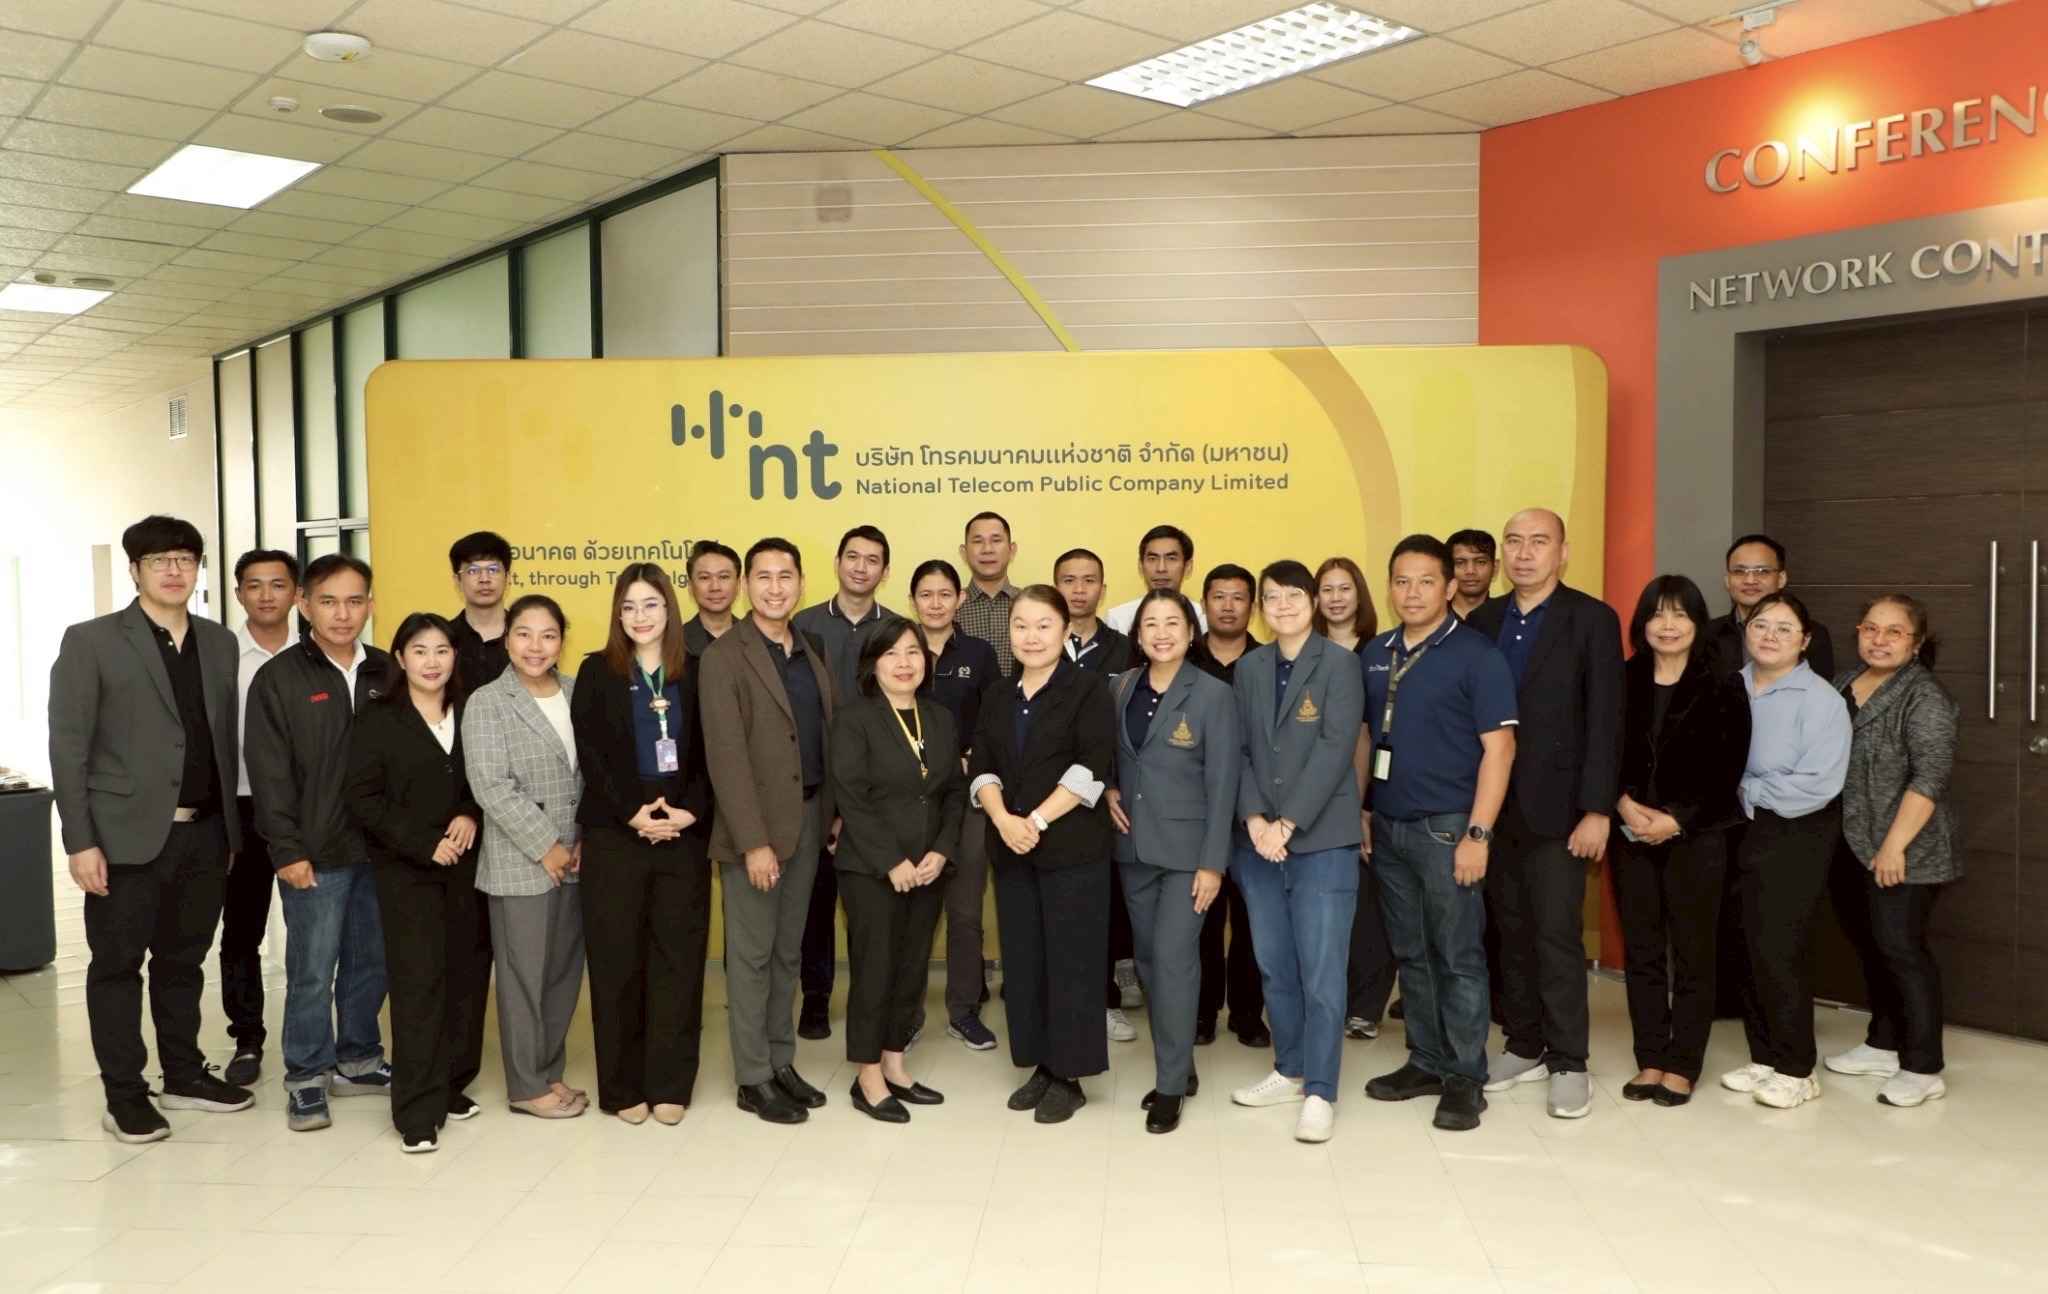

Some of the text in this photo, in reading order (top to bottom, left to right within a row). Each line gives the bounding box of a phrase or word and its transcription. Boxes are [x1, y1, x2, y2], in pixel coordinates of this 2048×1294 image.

[1704, 86, 2048, 193] CONFEREN
[1689, 229, 2048, 311] NETWORK CONT
[749, 430, 842, 500] nt
[855, 441, 1289, 467] บริษัท โทรคมนาคมแห่งชาติ จำกัด (มหาชน)
[856, 473, 1289, 495] National Telecom Public Company Limited
[528, 570, 601, 589] through
